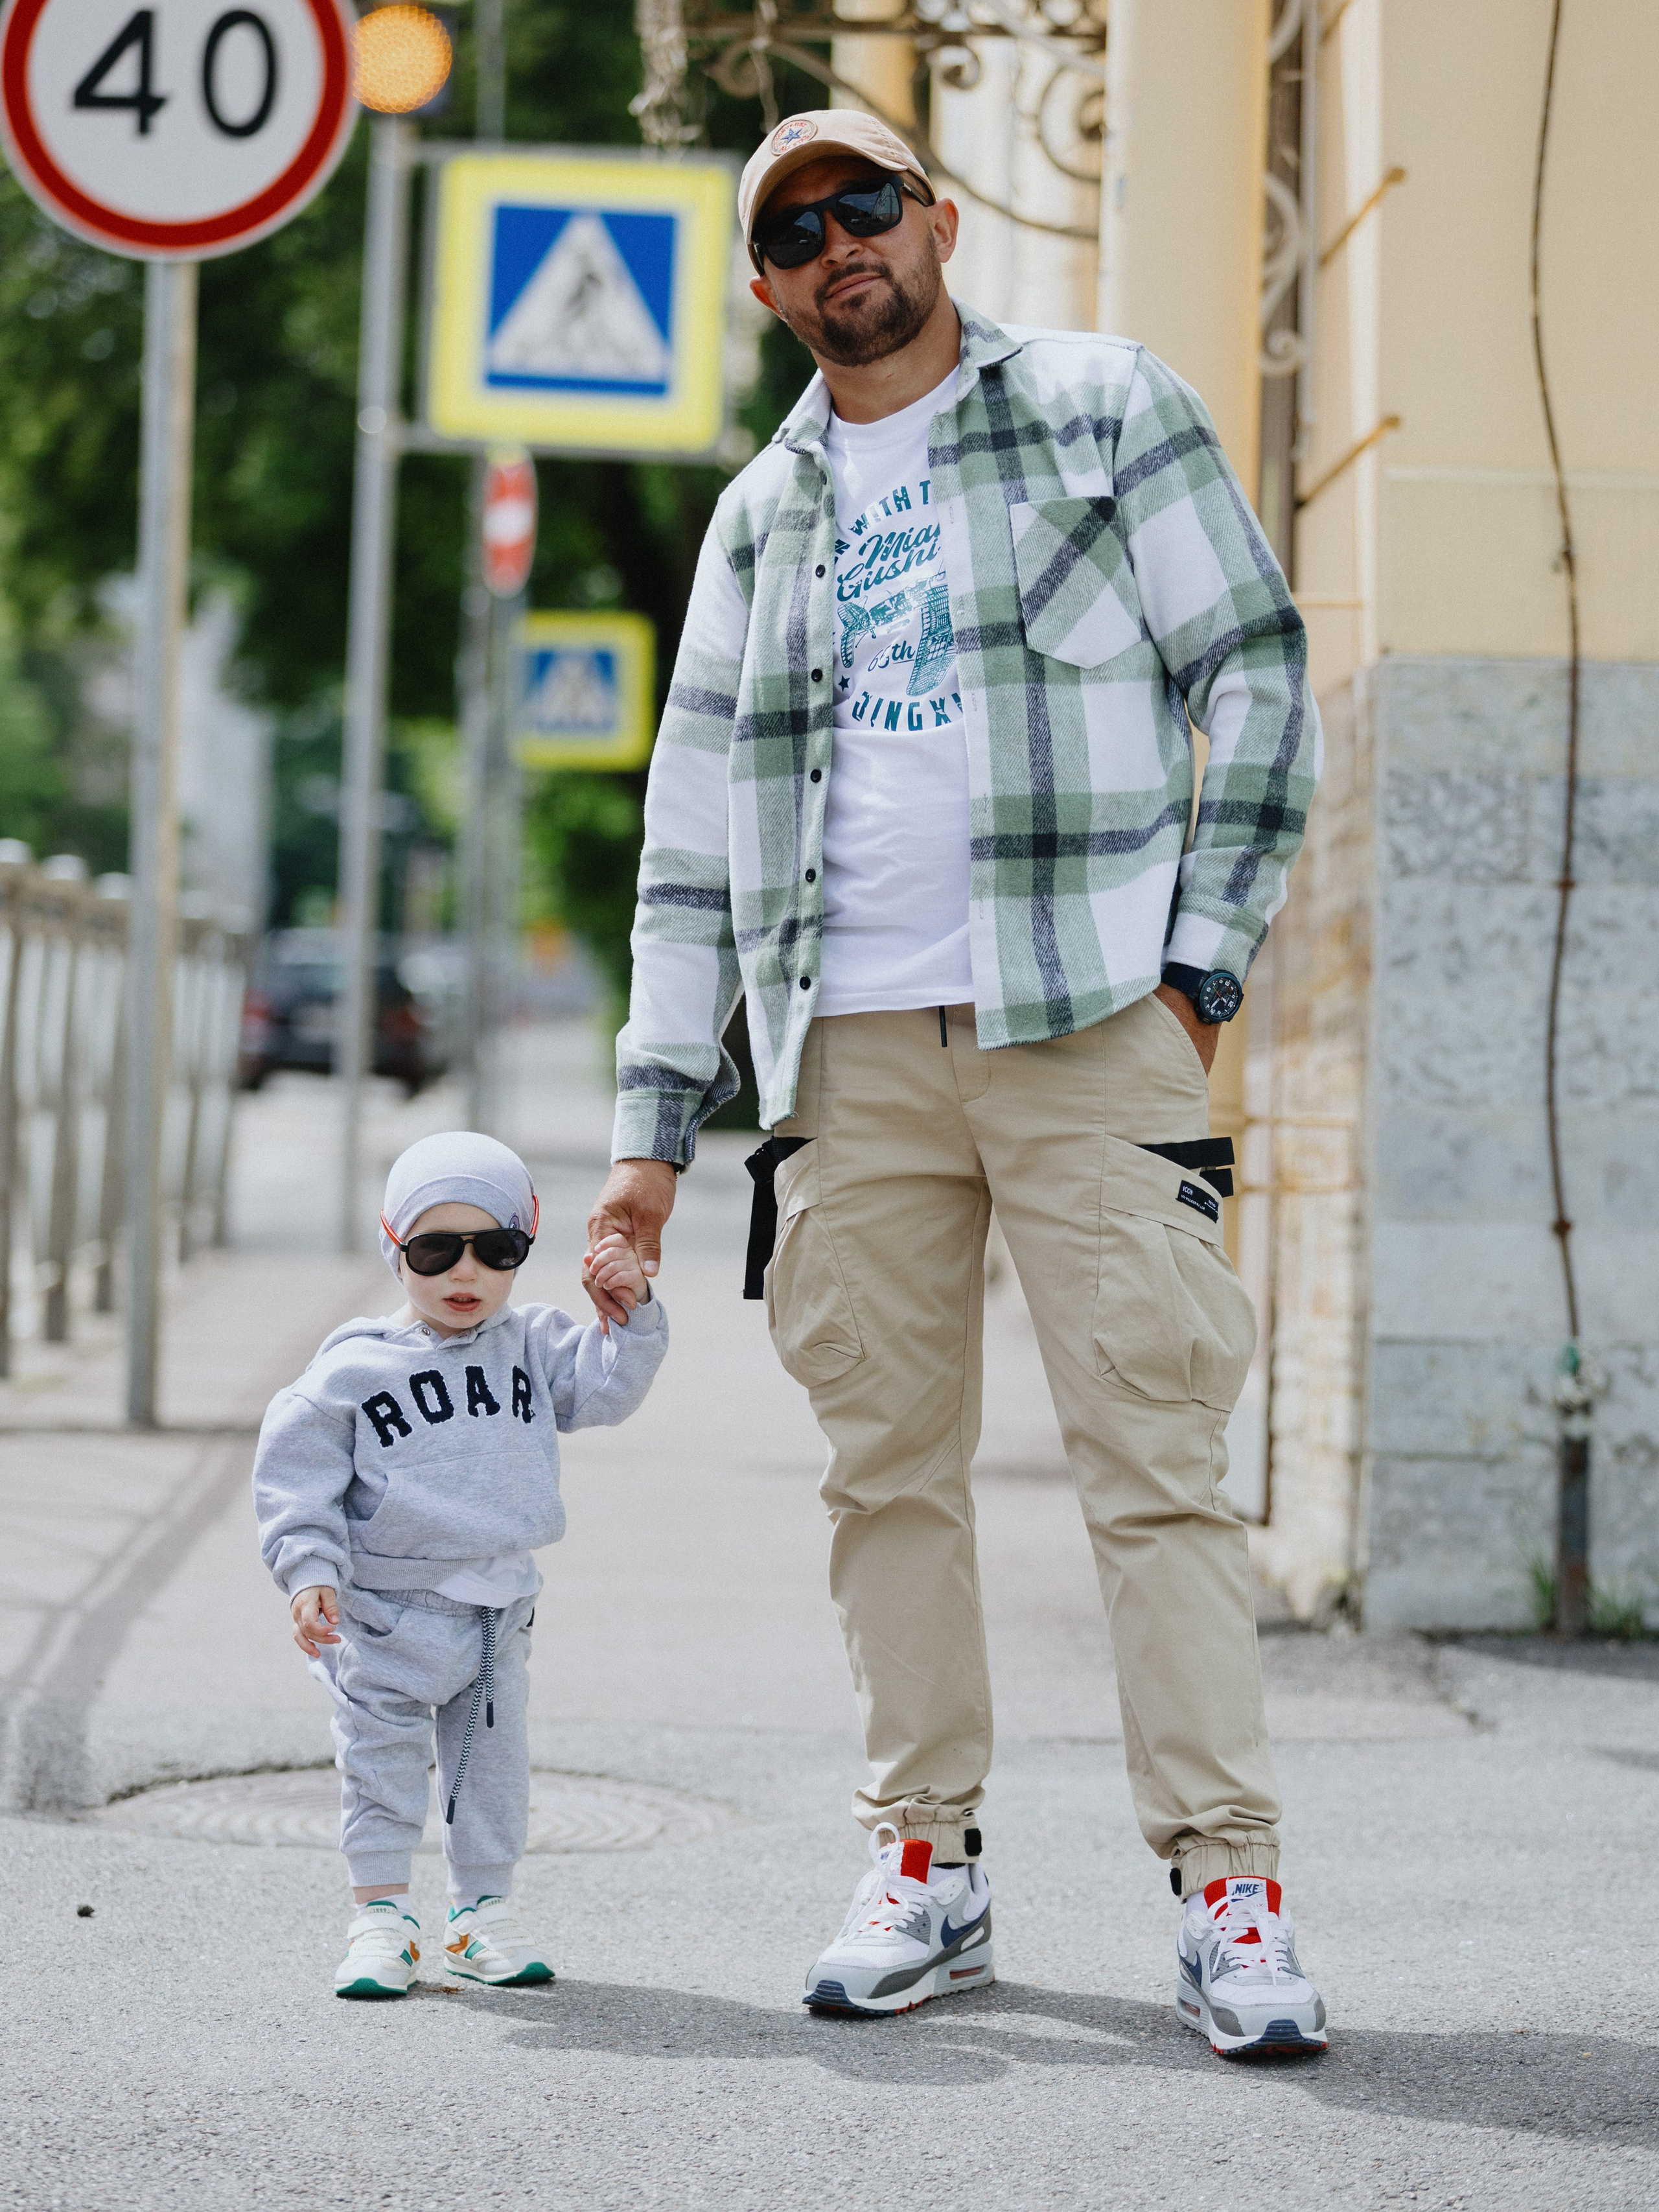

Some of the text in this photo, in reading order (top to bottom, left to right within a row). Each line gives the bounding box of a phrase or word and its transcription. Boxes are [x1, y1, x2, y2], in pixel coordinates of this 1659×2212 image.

[73, 10, 277, 137] 40
[848, 485, 911, 536] WITH
[858, 523, 941, 570] Mia
[360, 1364, 535, 1448] ROAR
[1235, 1883, 1260, 1894] NIKE
